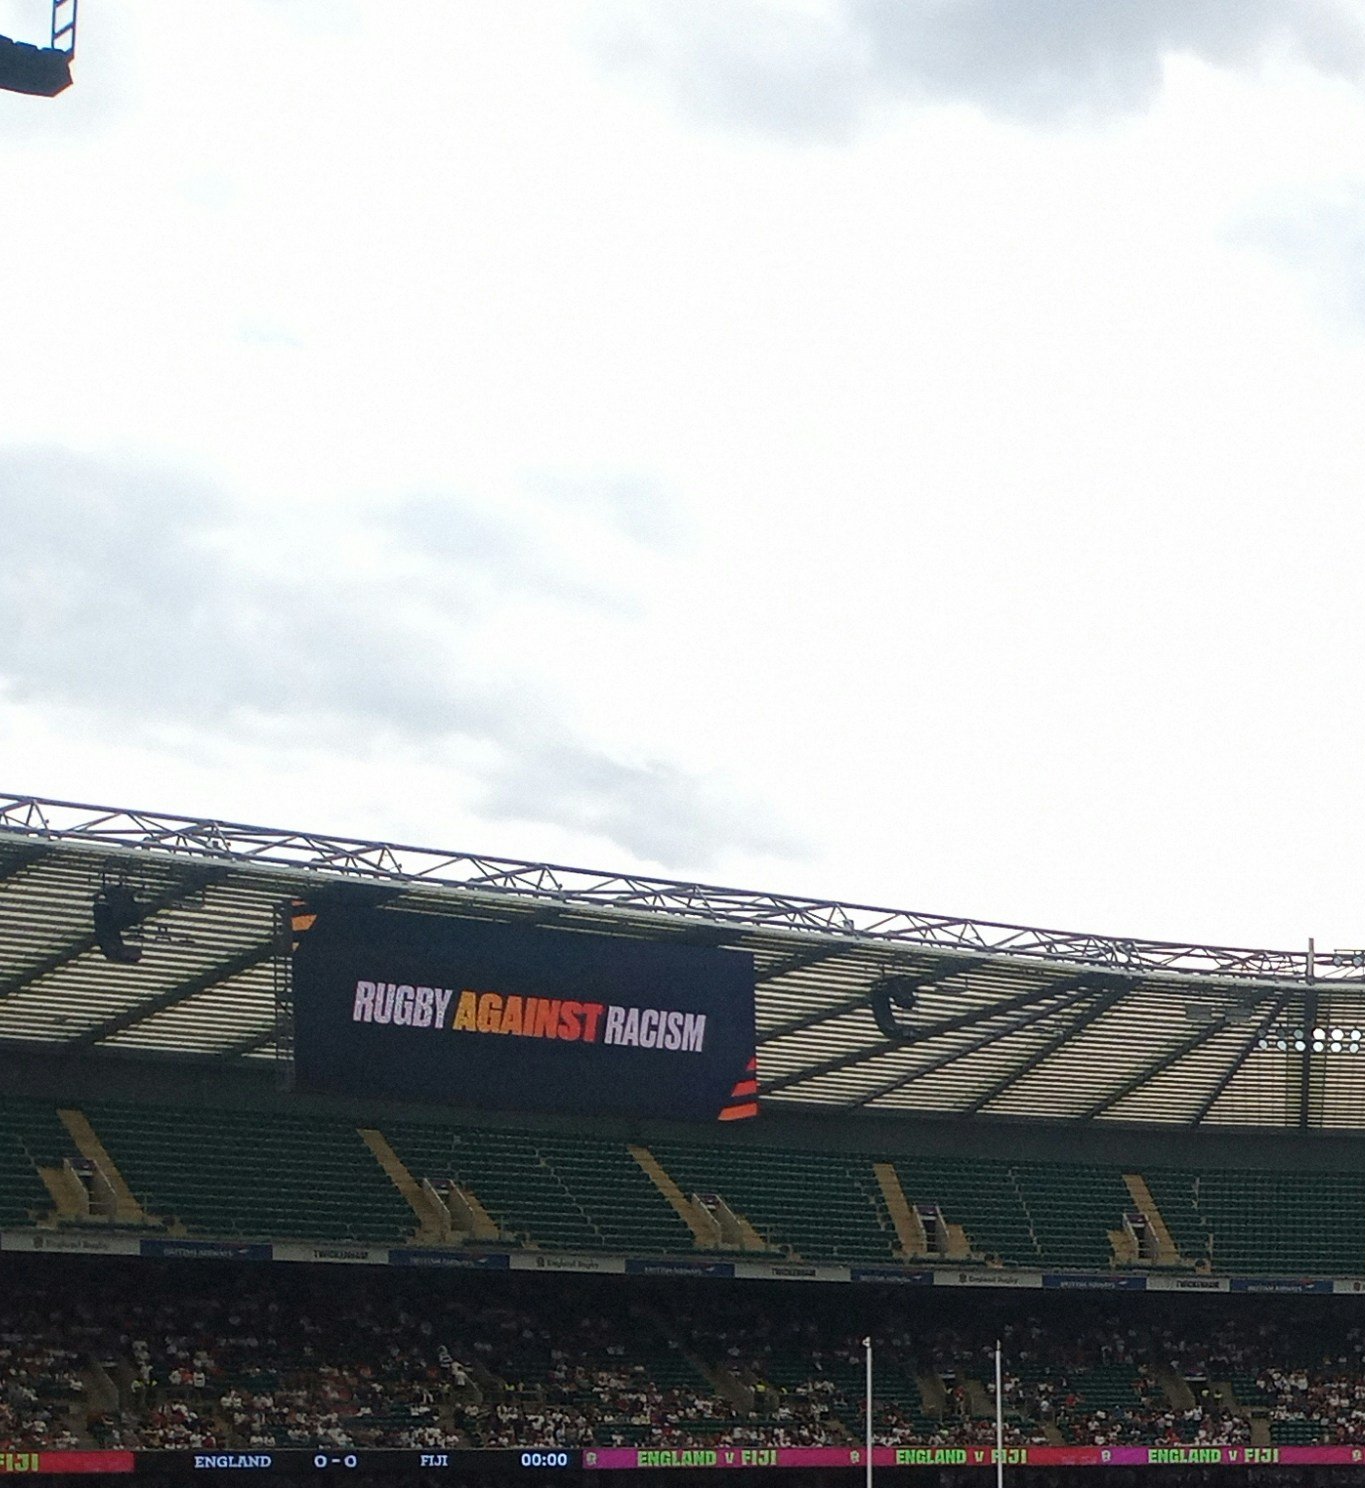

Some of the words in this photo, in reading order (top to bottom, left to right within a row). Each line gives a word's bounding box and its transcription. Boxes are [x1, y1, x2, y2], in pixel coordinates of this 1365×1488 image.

[353, 980, 452, 1029] RUGBY
[452, 990, 604, 1042] AGAINST
[604, 1005, 706, 1052] RACISM
[194, 1455, 271, 1468] ENGLAND
[420, 1455, 448, 1467] FIJI
[521, 1453, 568, 1466] 00:00
[637, 1450, 717, 1467] ENGLAND
[741, 1449, 777, 1466] FIJI
[896, 1449, 967, 1465] ENGLAND
[1148, 1449, 1221, 1464] ENGLAND
[1244, 1448, 1279, 1463] FIJI
